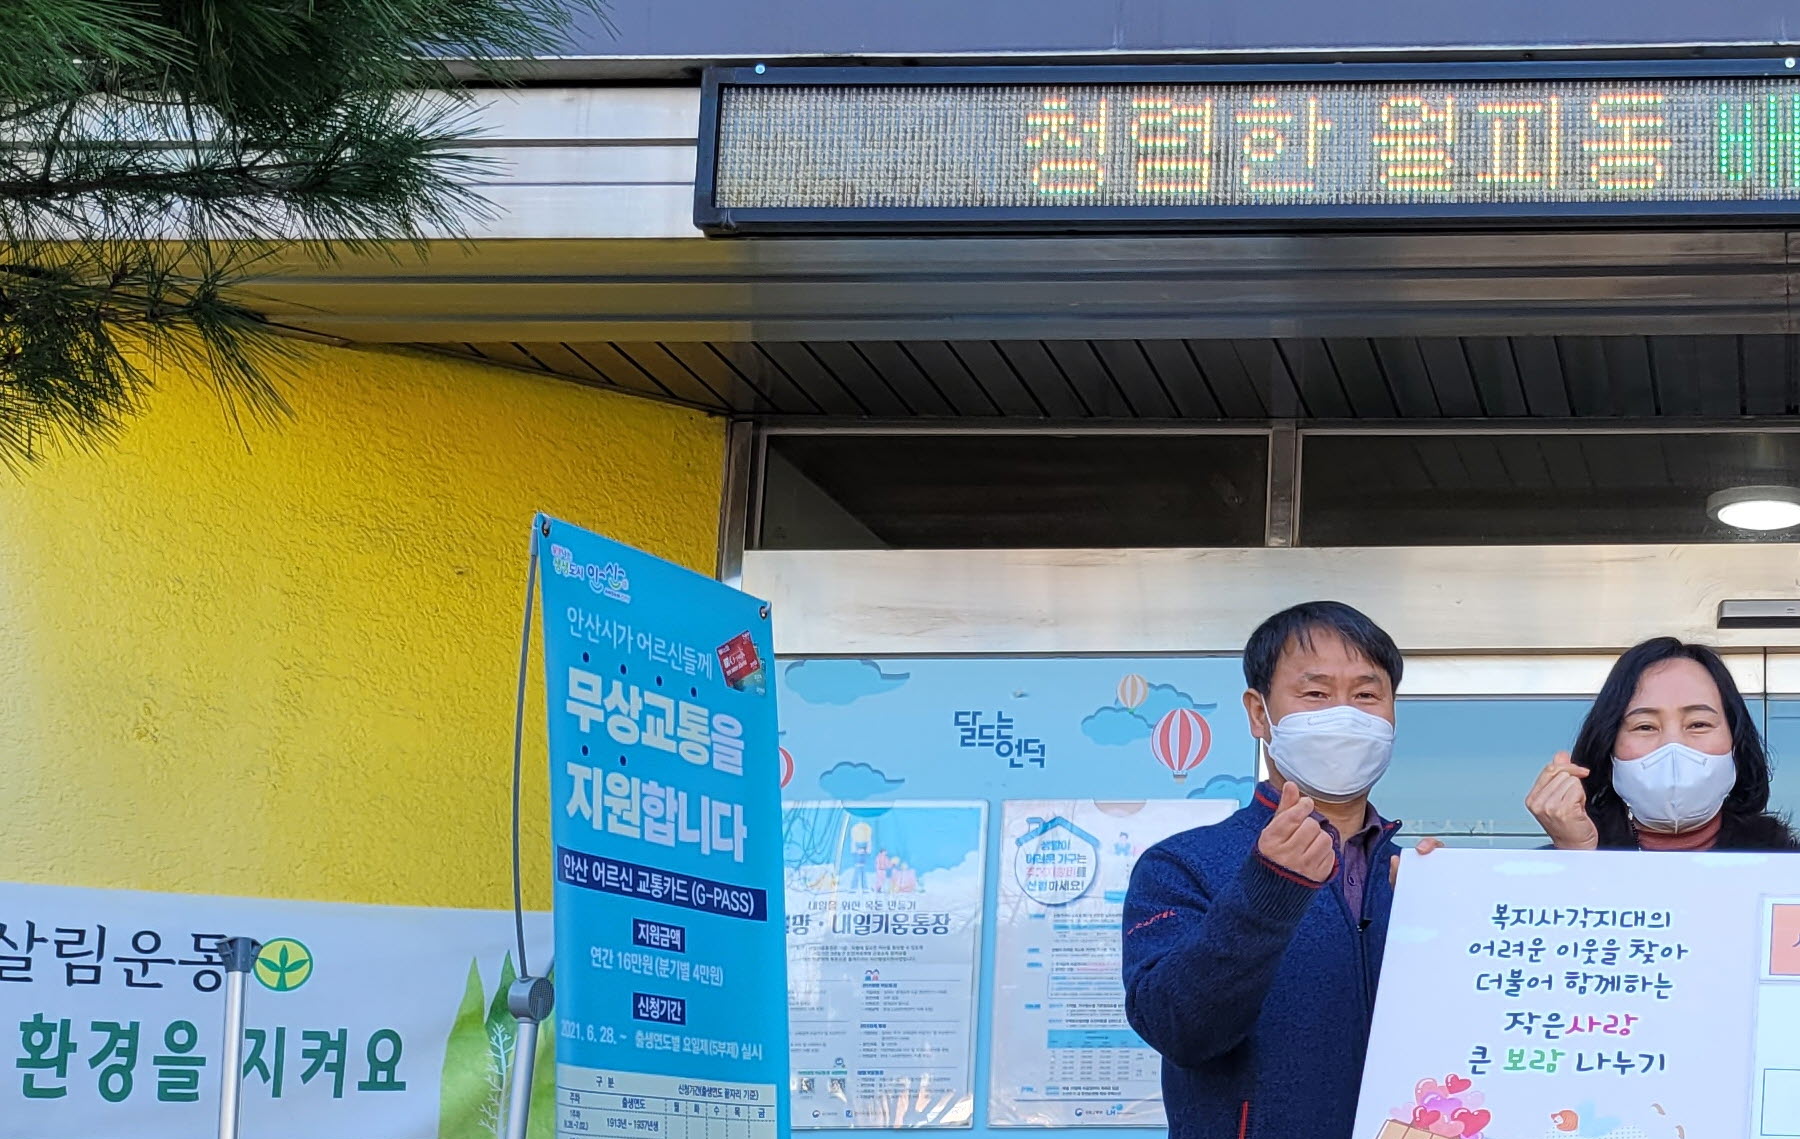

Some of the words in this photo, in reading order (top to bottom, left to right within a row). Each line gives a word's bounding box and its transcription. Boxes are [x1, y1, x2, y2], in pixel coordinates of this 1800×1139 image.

[1372, 92, 1673, 192] 월피동
[567, 607, 633, 653] 안산시가
[637, 632, 712, 680] 어르신들께
[566, 667, 745, 776] 무상교통을
[994, 736, 1046, 769] 언덕
[566, 762, 748, 863] 지원합니다
[564, 854, 588, 883] 안산
[593, 862, 633, 892] 어르신
[637, 871, 689, 901] 교통카드
[1491, 904, 1671, 931] 복지사각지대의
[638, 923, 681, 950] 지원금액
[1469, 938, 1546, 963] 어려운
[1556, 938, 1621, 966] 이웃을
[1629, 938, 1688, 965] 찾아
[1476, 969, 1554, 997] 더불어
[1565, 970, 1674, 999] 함께하는
[638, 996, 681, 1021] 신청기간
[16, 1012, 206, 1102] 환경을
[243, 1026, 407, 1099] 지켜요
[1469, 1046, 1492, 1075] 큰
[1503, 1048, 1566, 1074] 보람
[1575, 1051, 1666, 1076] 나누기
